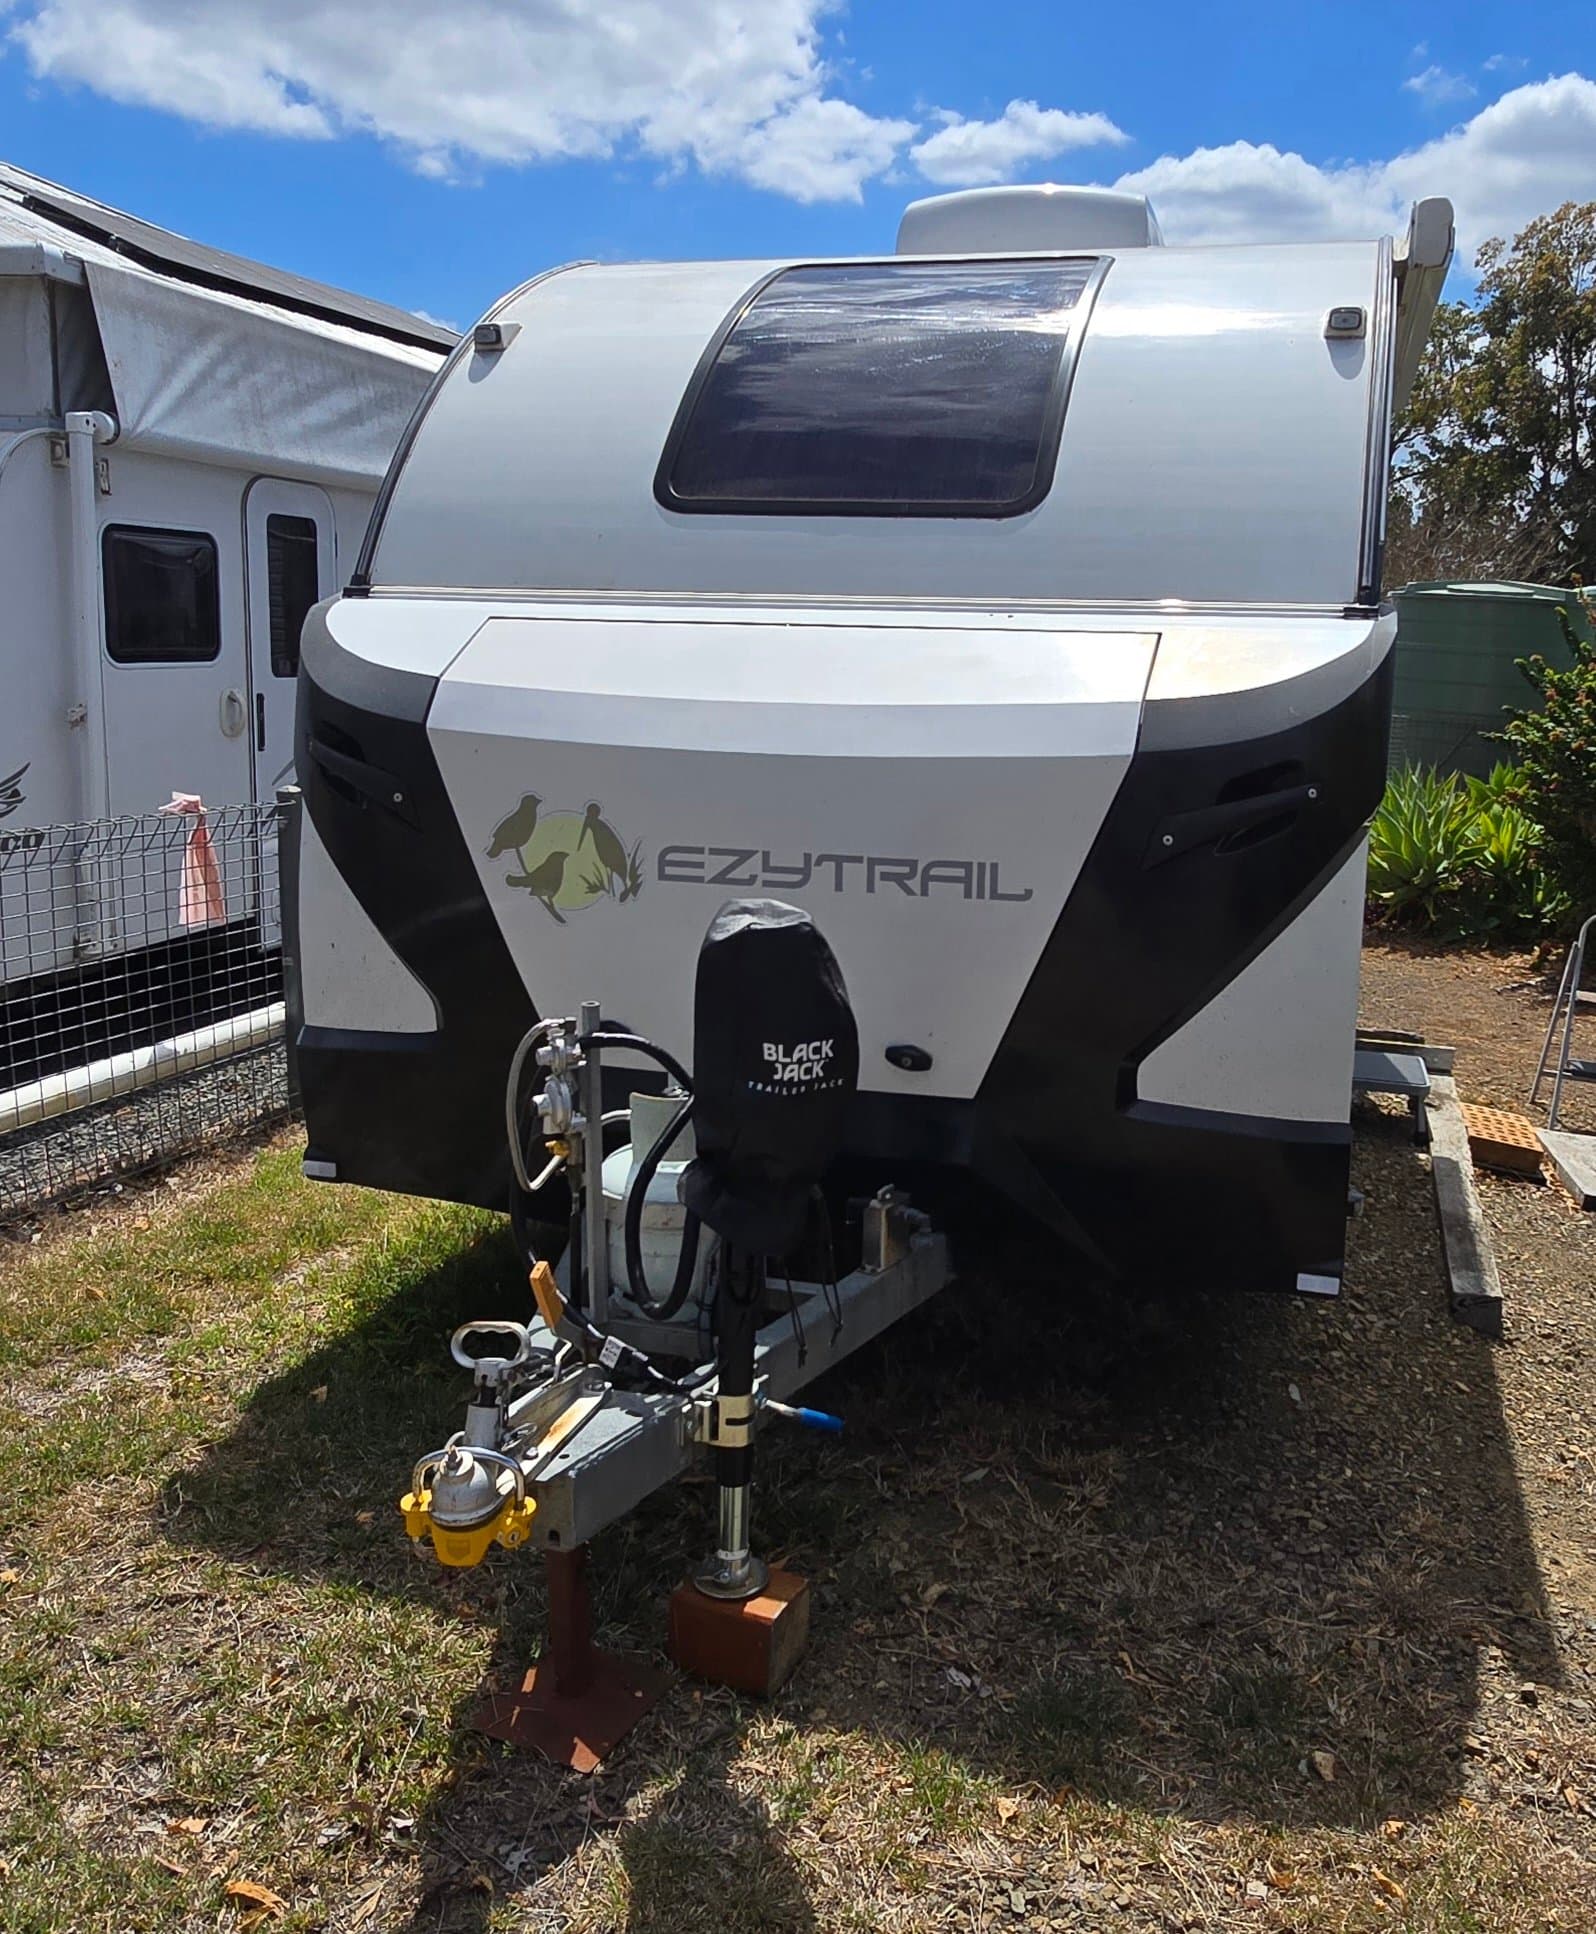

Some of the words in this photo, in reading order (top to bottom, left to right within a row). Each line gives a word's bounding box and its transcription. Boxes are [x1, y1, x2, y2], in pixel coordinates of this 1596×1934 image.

[657, 845, 1034, 902] EZYTRAIL
[762, 1039, 834, 1062] BLACK
[773, 1060, 825, 1082] JACK
[748, 1081, 806, 1096] TRAILER
[813, 1078, 844, 1091] JACK
